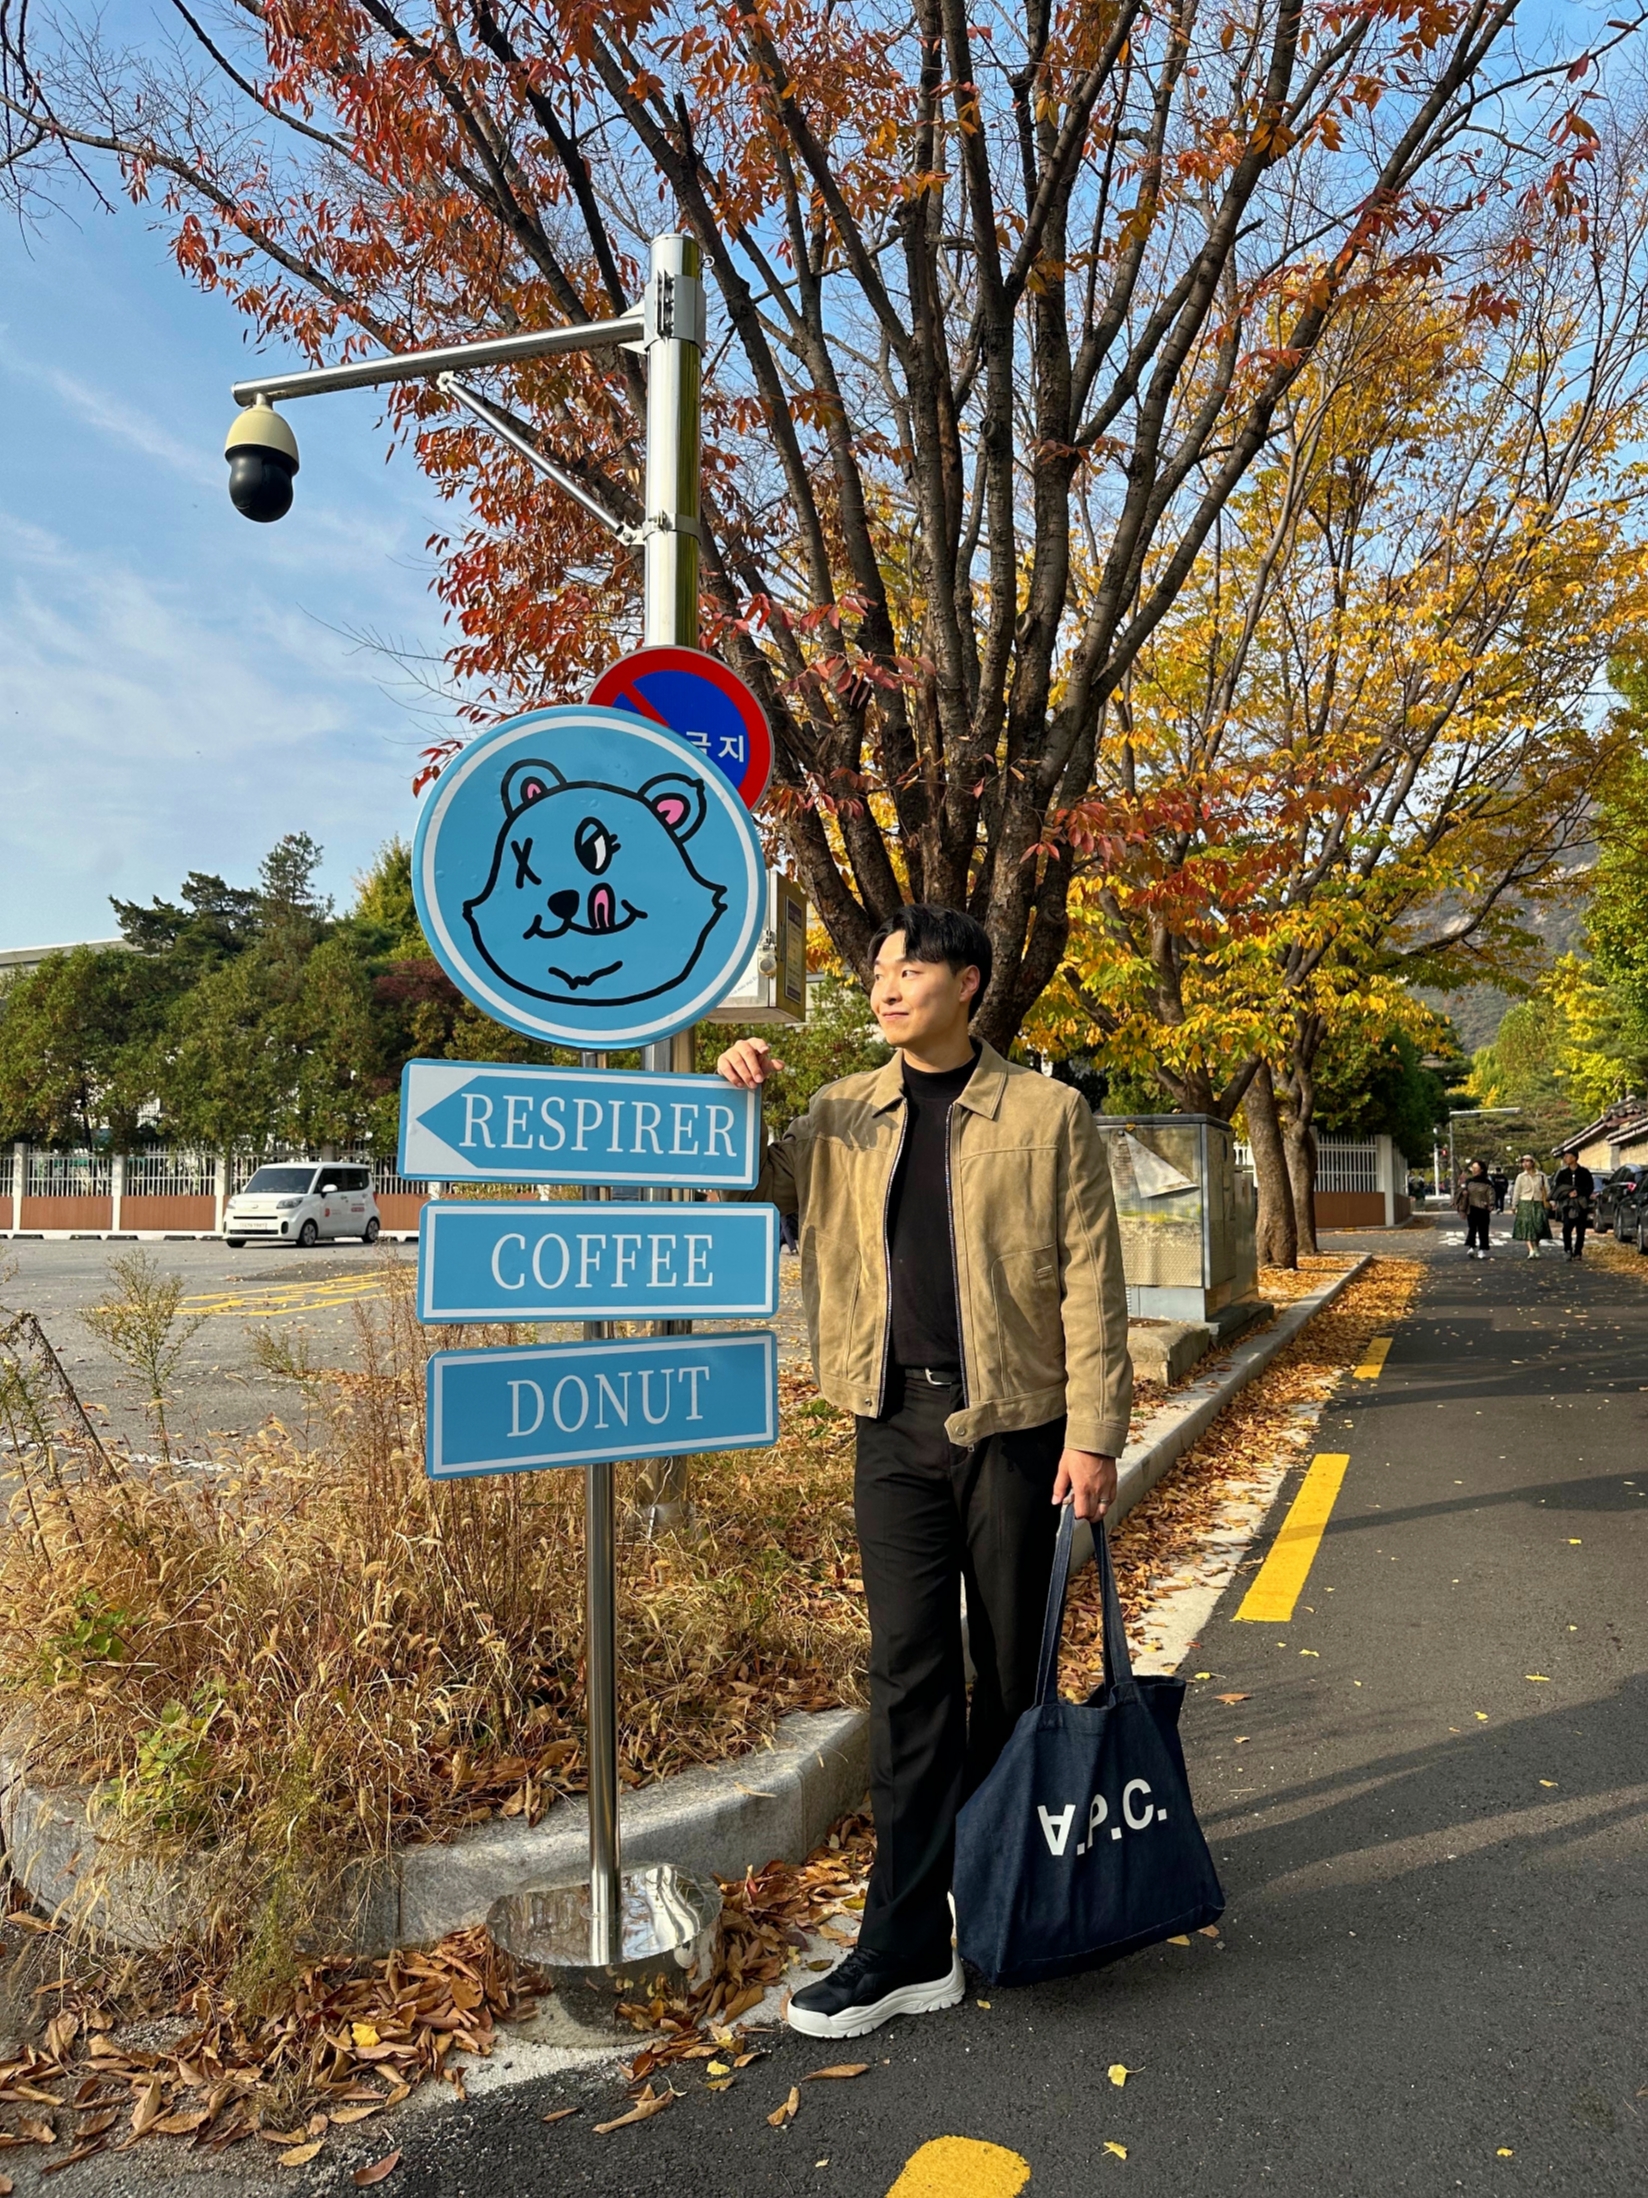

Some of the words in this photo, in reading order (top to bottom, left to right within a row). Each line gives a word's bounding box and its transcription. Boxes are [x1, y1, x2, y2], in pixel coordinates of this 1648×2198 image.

[459, 1093, 737, 1157] RESPIRER
[491, 1233, 713, 1290] COFFEE
[507, 1366, 710, 1437] DONUT
